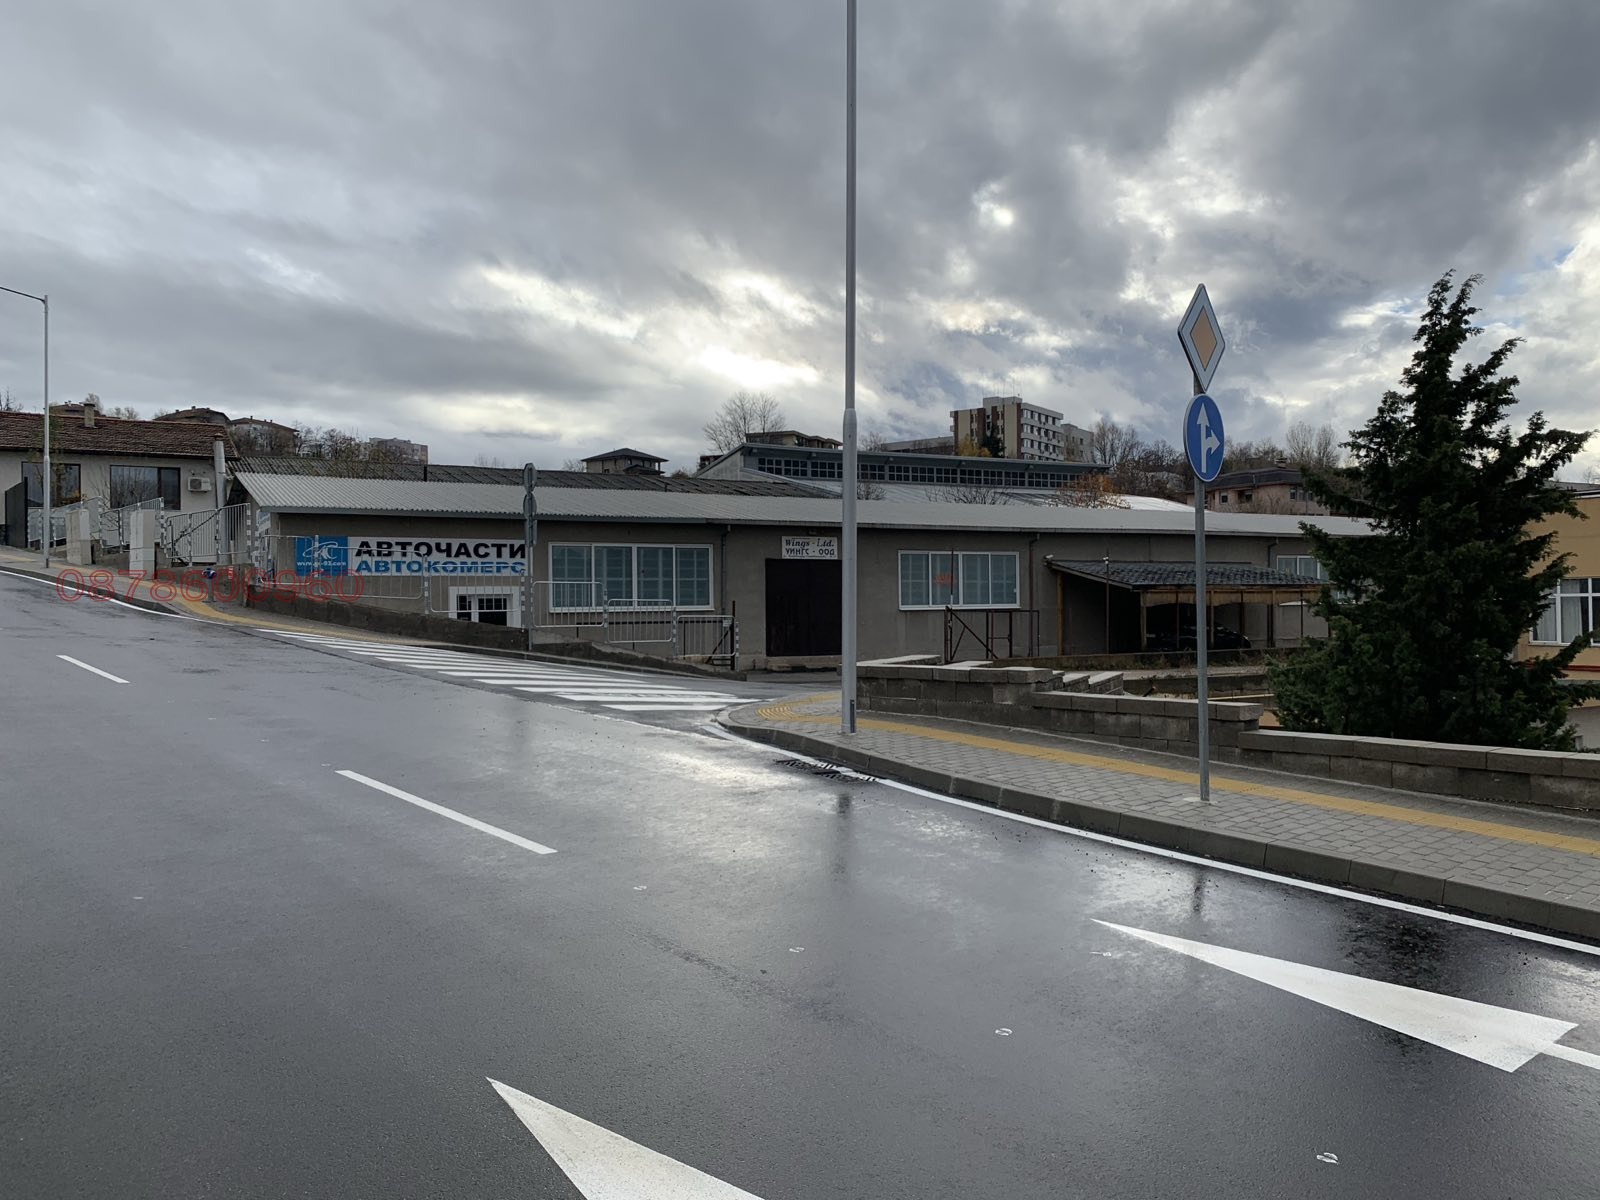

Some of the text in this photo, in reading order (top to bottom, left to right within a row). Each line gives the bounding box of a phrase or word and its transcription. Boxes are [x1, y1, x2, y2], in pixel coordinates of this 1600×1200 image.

[785, 539, 810, 548] Wings
[355, 541, 526, 559] АВТОЧАСТИ
[785, 547, 810, 555] УИНГС
[818, 548, 835, 556] ООД
[356, 560, 527, 574] АВТОКОМЕРС
